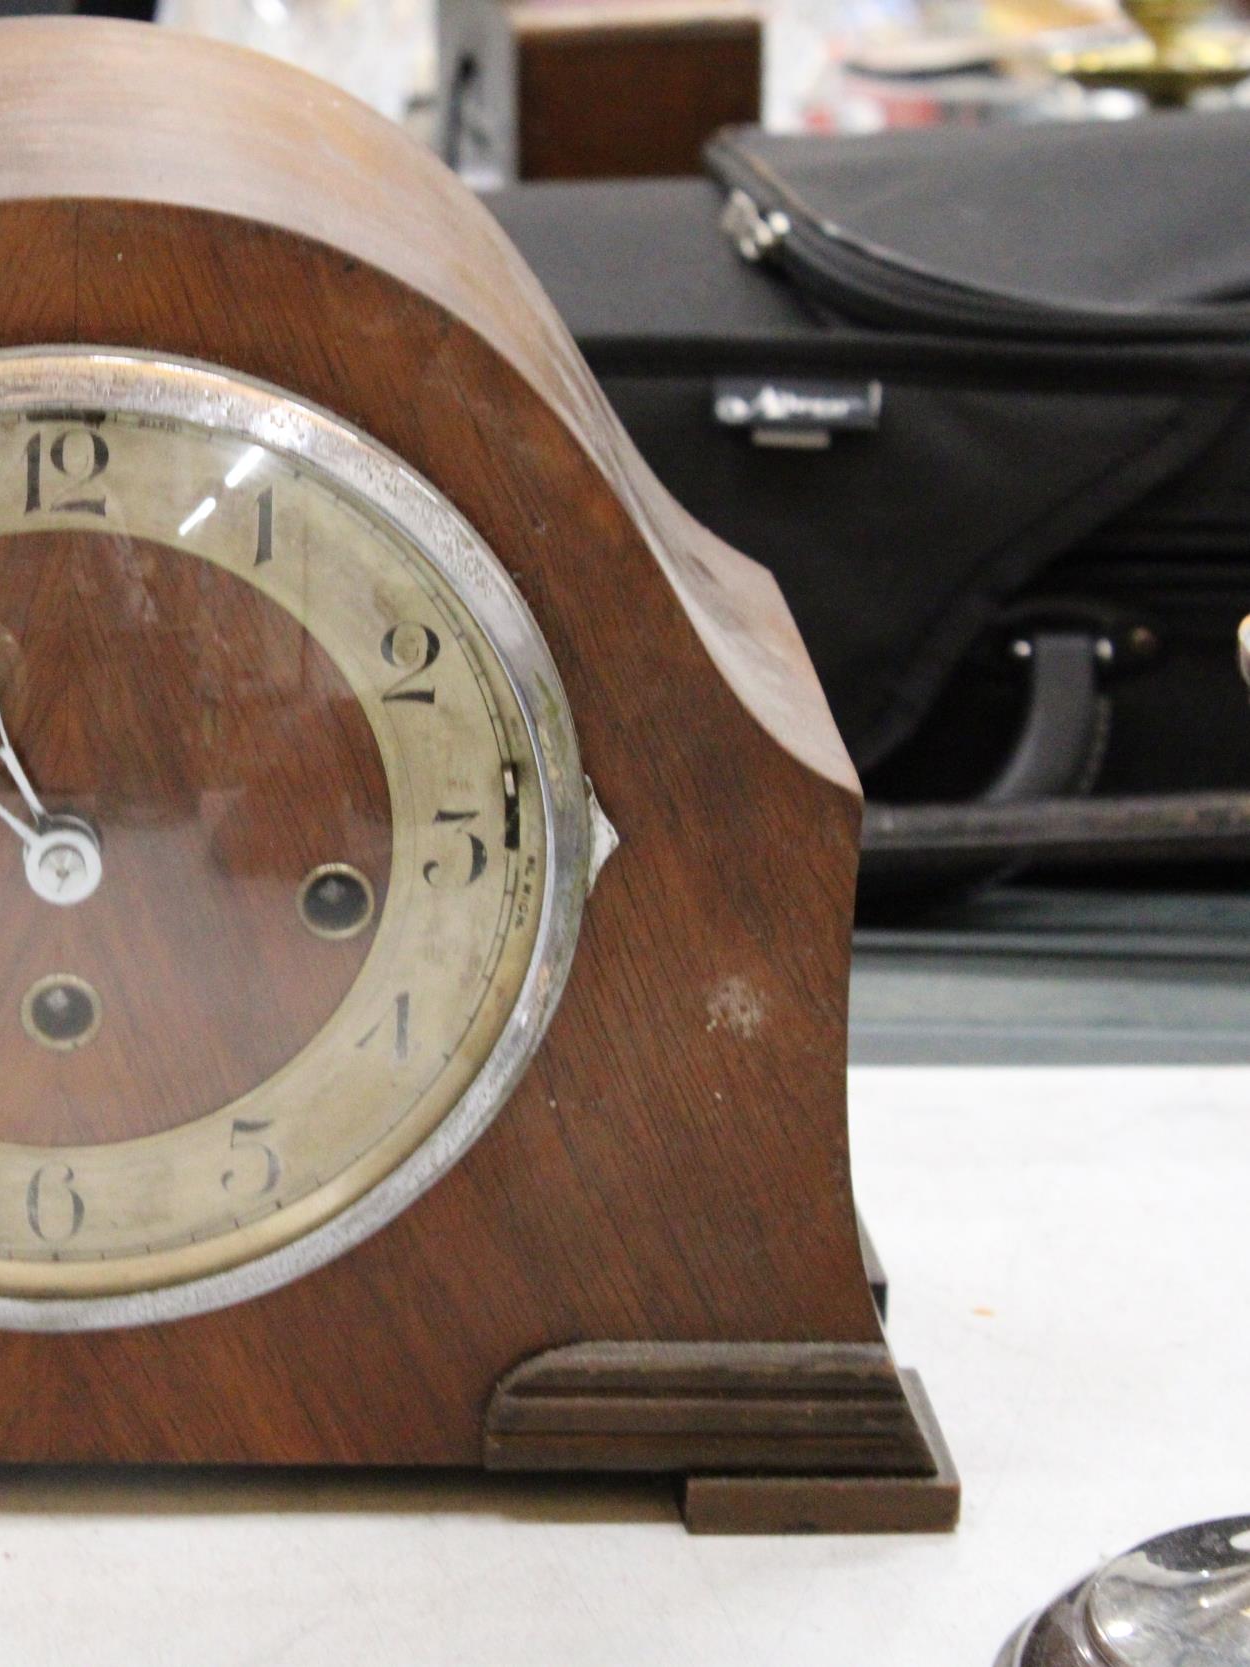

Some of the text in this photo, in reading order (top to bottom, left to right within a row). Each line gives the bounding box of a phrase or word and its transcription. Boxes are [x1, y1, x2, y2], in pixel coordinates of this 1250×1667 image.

[23, 430, 109, 518] 12
[253, 483, 273, 567] 1
[380, 621, 440, 704] 2
[423, 808, 488, 888] 3
[221, 1118, 281, 1195] 5
[25, 1163, 85, 1243] 6
